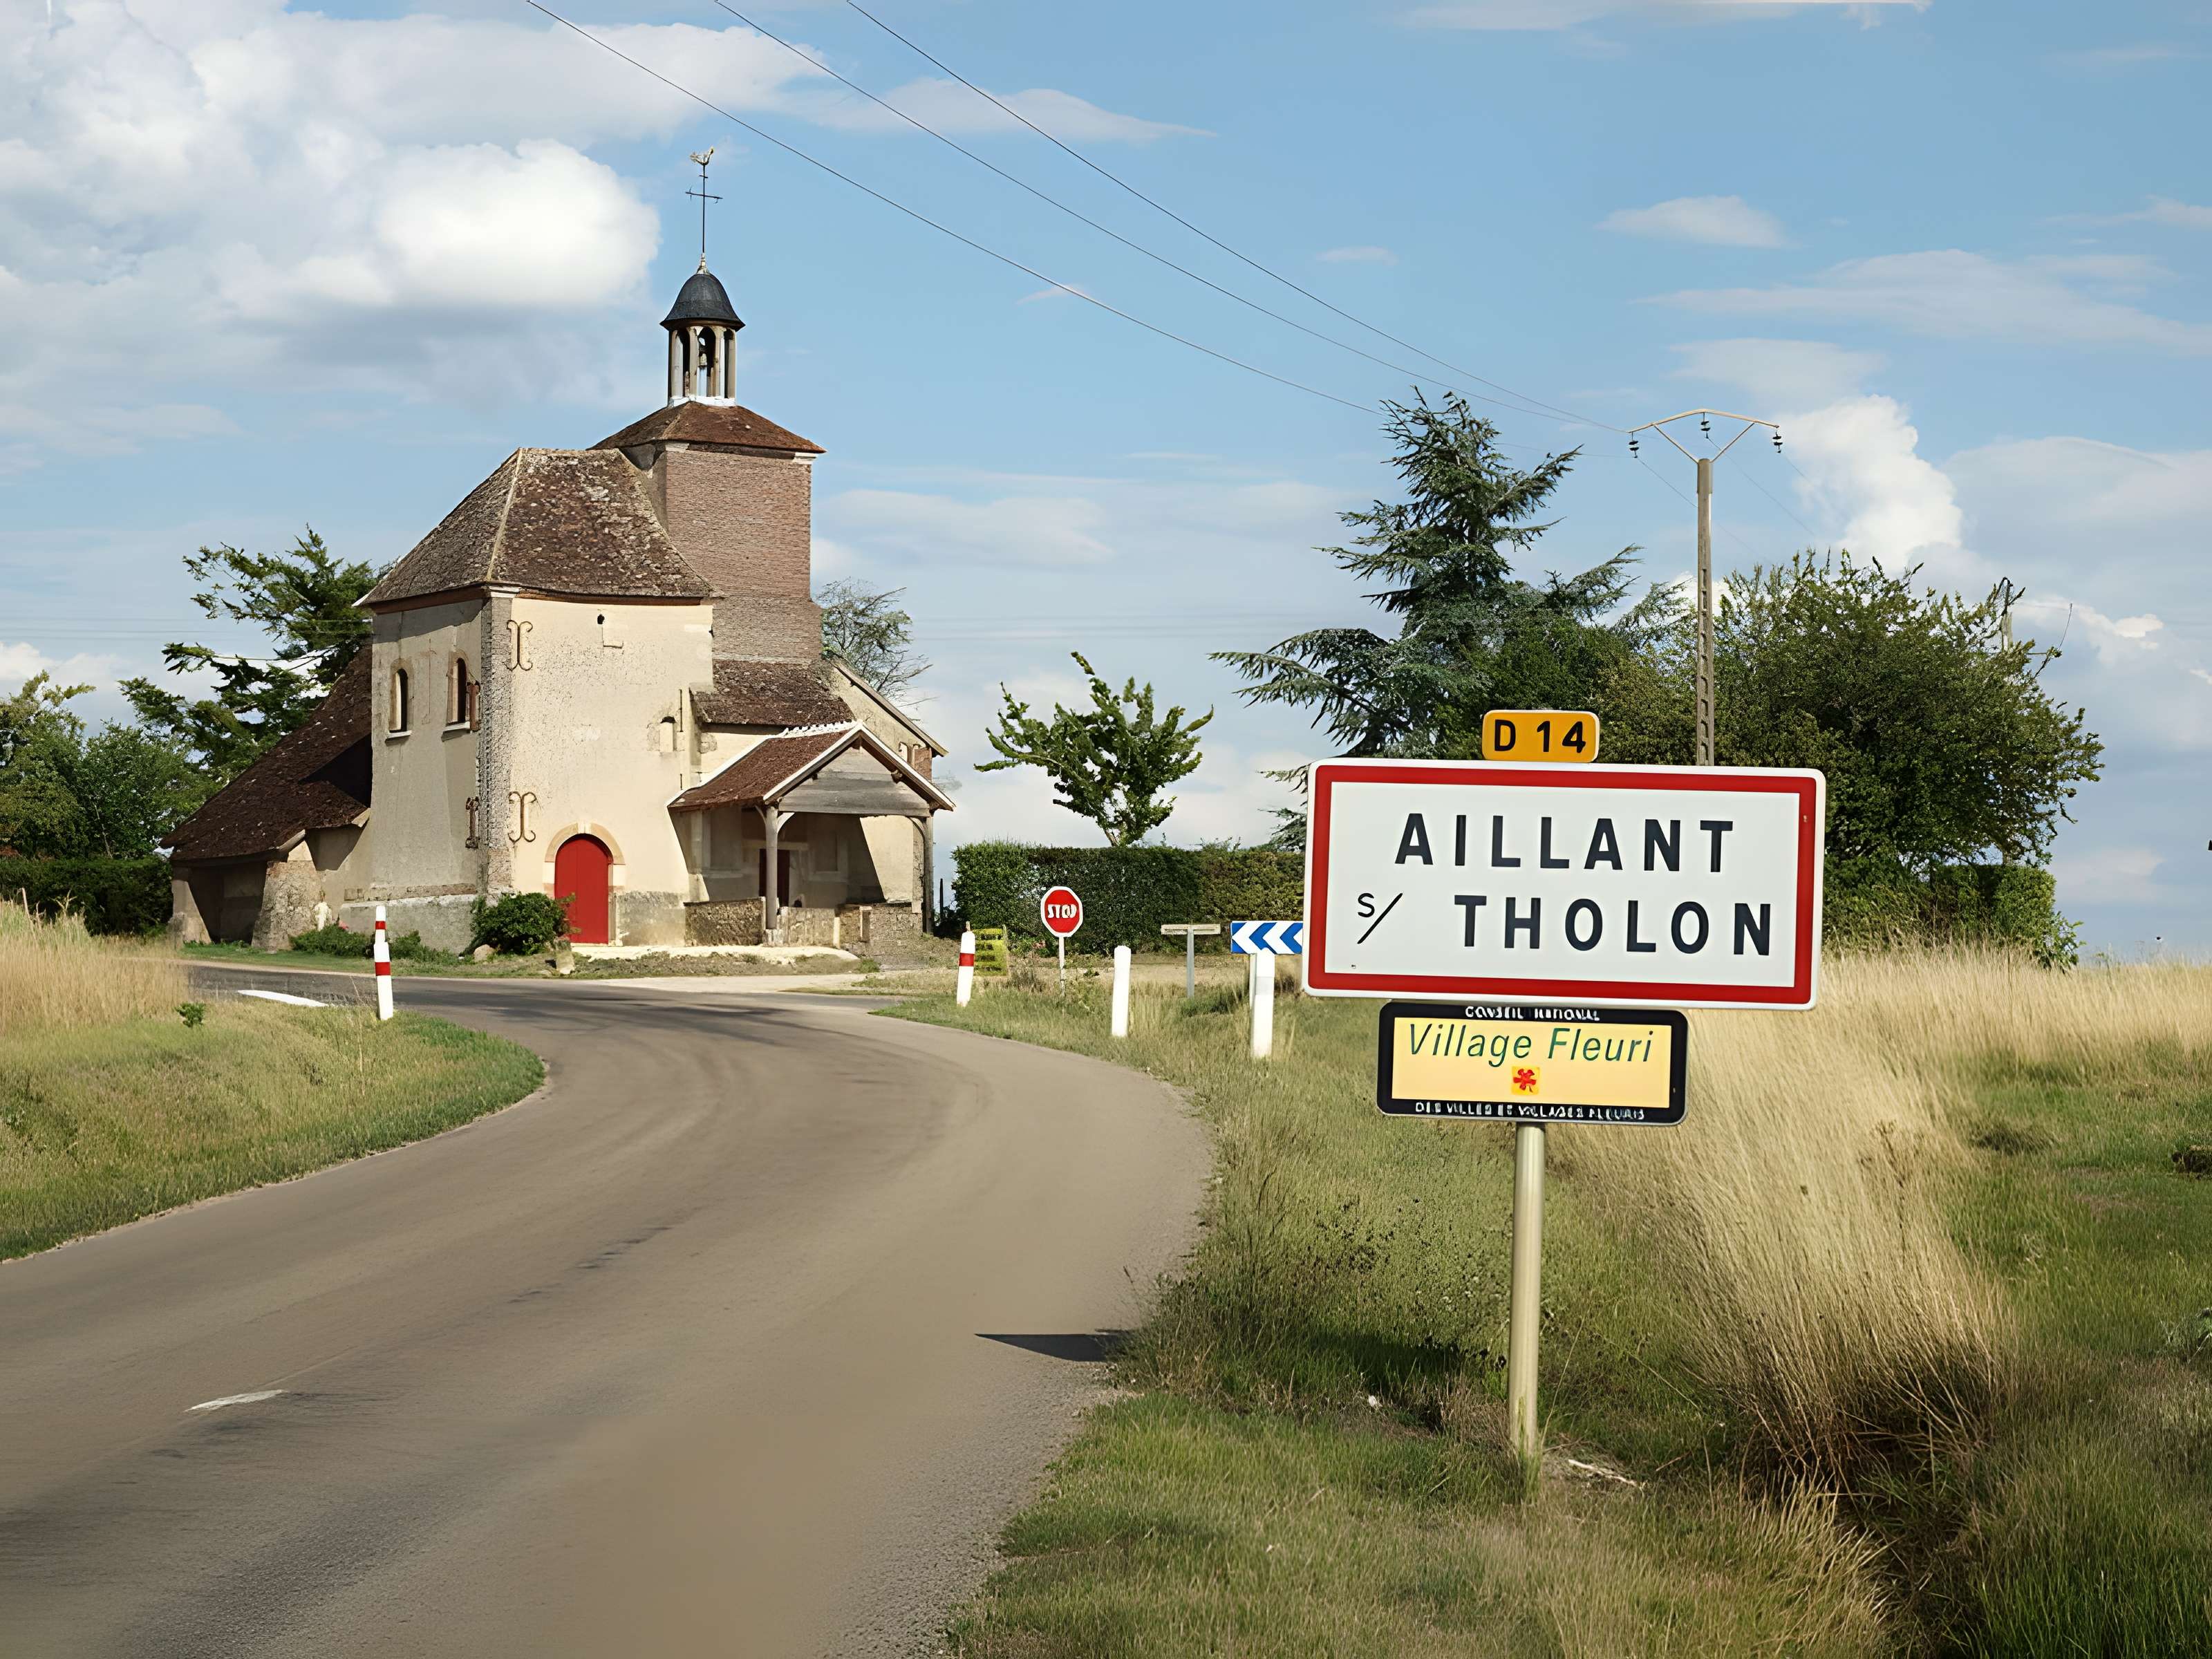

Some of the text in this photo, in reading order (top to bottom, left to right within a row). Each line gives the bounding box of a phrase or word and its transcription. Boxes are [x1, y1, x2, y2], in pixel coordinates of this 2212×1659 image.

[1494, 719, 1586, 753] D 14
[1394, 813, 1734, 873] AILLANT
[1047, 903, 1078, 919] STOP
[1454, 894, 1771, 956] THOLON
[1410, 1023, 1653, 1068] Village Fleuri
